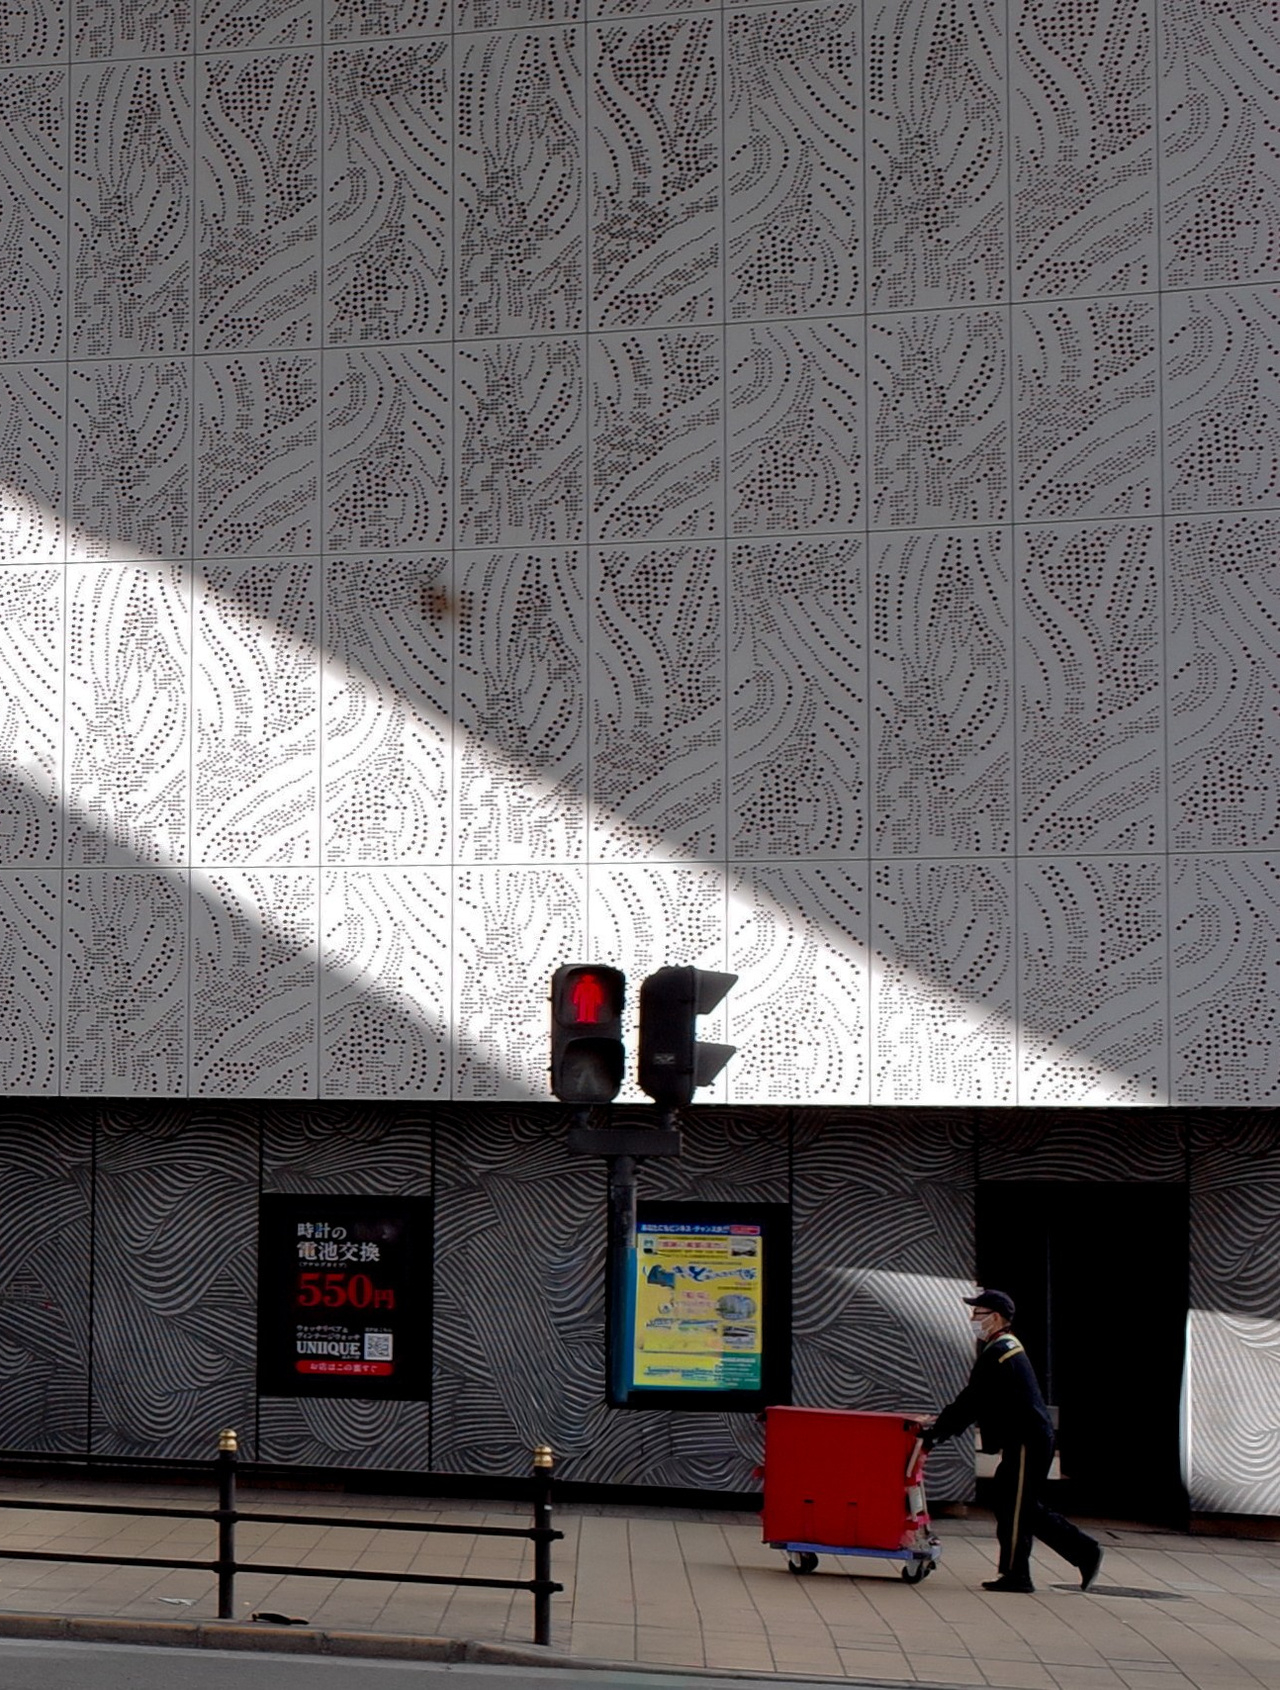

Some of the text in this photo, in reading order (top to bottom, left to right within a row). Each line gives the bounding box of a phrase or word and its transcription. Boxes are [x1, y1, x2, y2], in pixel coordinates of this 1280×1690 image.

[297, 1222, 347, 1240] 時計の
[297, 1241, 381, 1262] 電池交換
[297, 1272, 395, 1309] 550円
[296, 1340, 361, 1357] UNIIQUE
